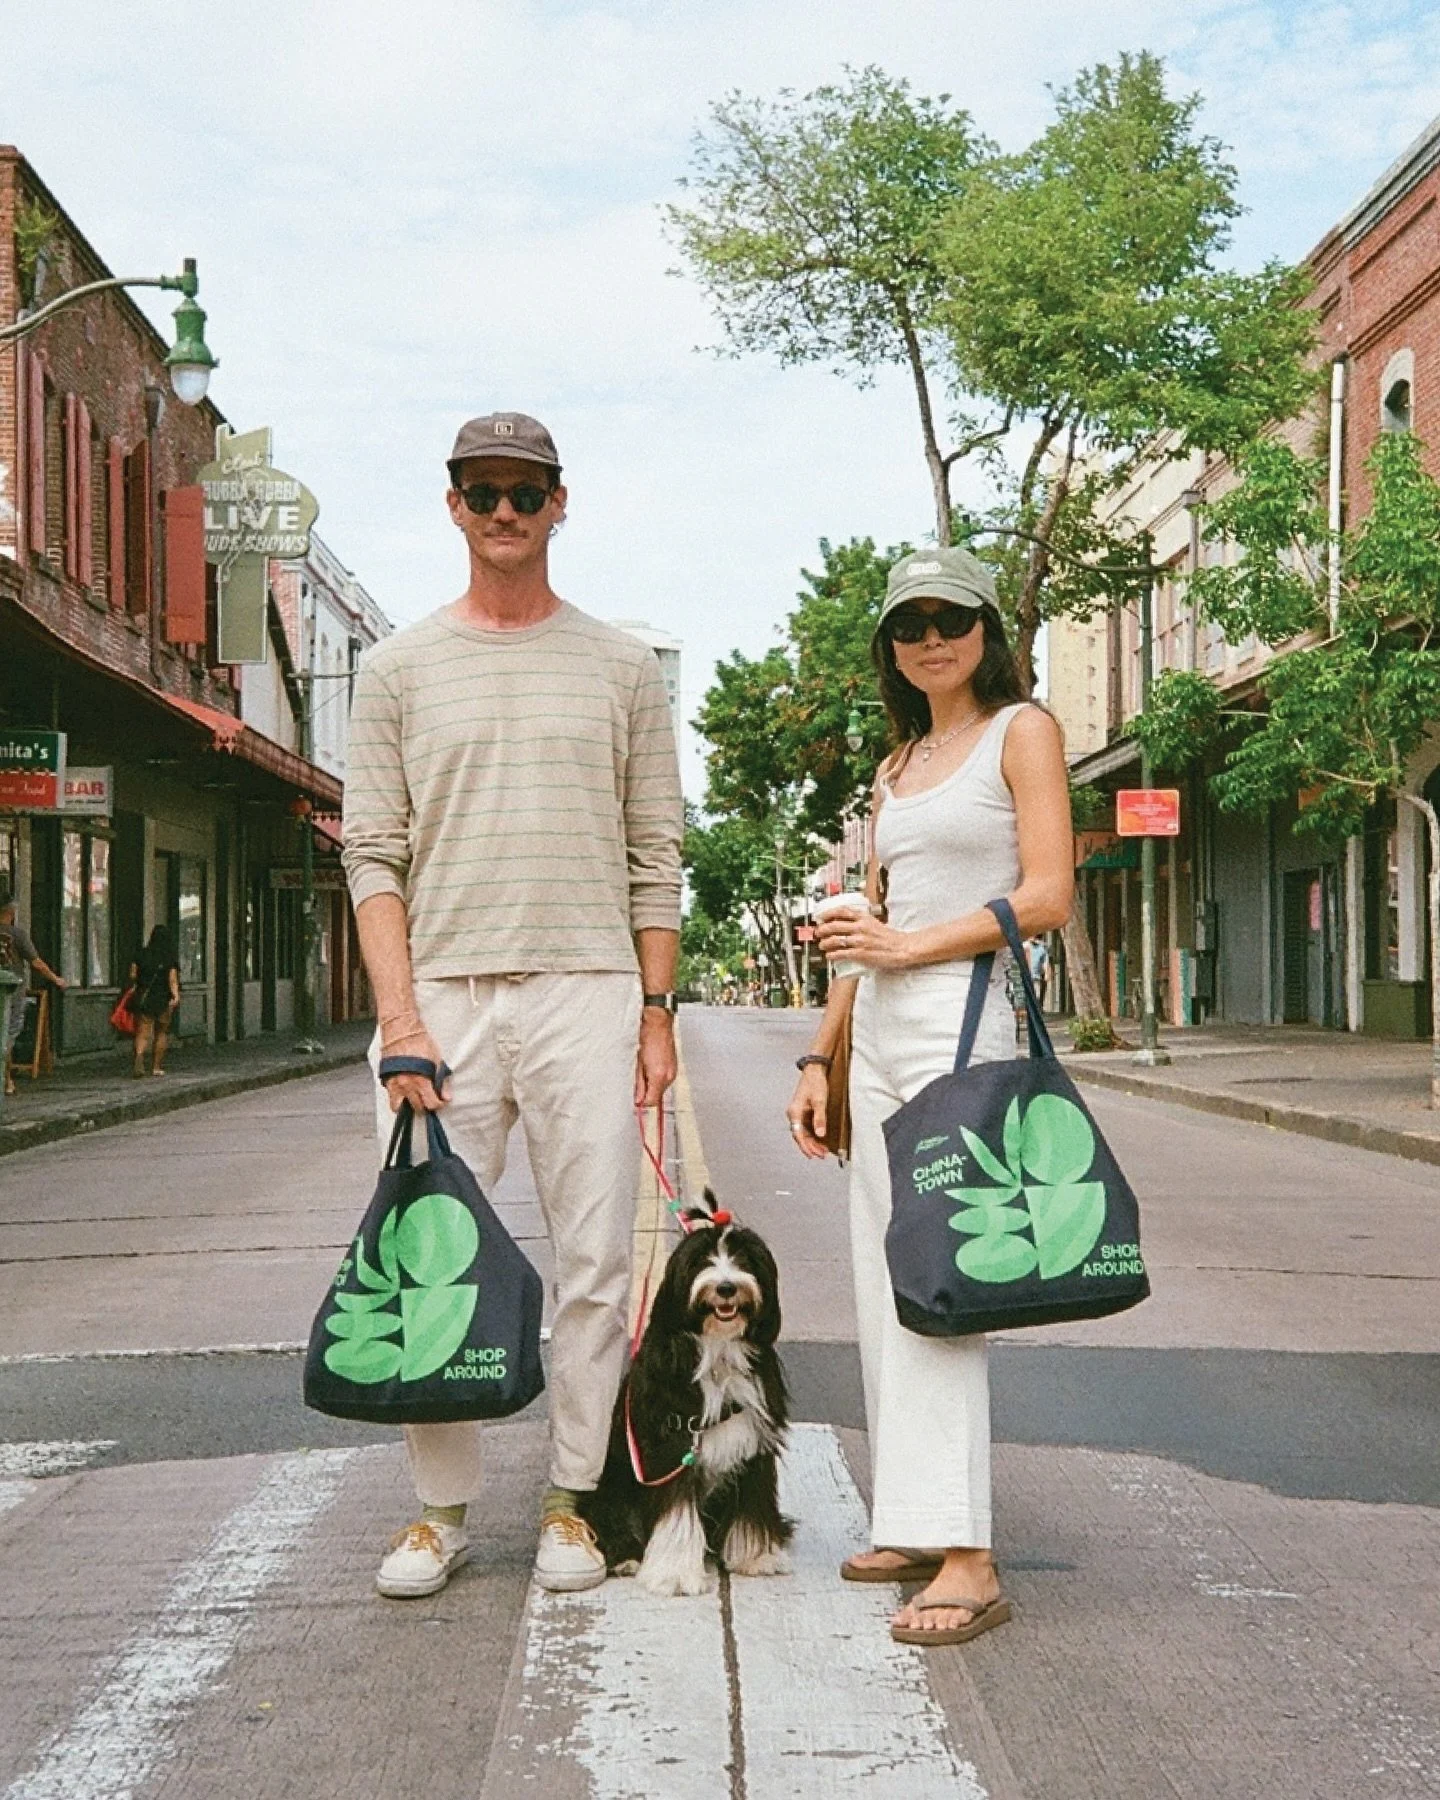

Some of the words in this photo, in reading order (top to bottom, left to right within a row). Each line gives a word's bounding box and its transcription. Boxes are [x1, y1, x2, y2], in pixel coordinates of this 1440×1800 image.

[204, 505, 301, 531] LIVE
[64, 780, 105, 796] BAR
[912, 1153, 968, 1181] CHINA-
[914, 1167, 964, 1195] TOWN
[1081, 1260, 1144, 1277] AROUND
[464, 1347, 507, 1363] SHOP
[443, 1363, 507, 1381] AROUND
